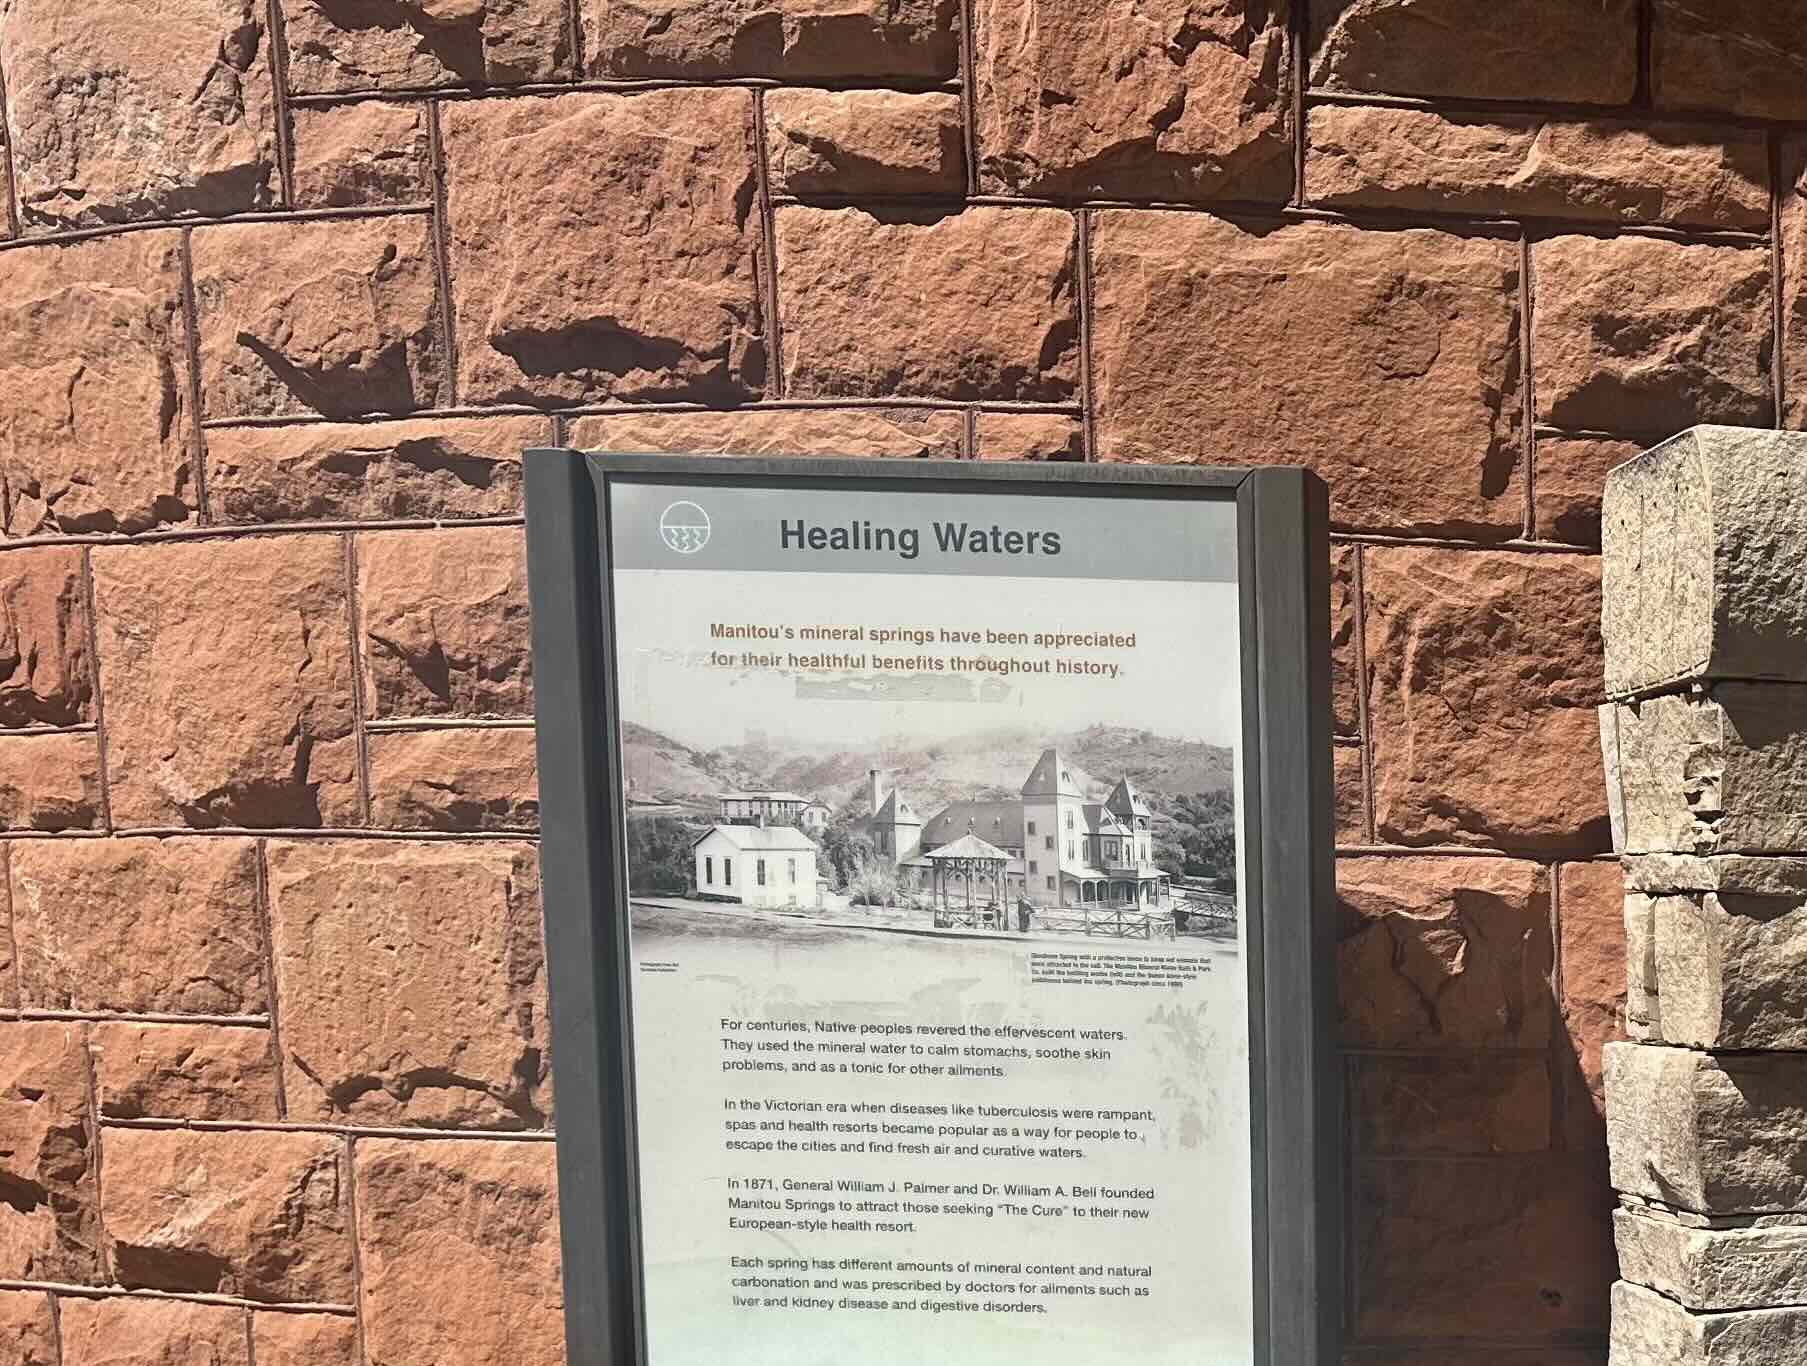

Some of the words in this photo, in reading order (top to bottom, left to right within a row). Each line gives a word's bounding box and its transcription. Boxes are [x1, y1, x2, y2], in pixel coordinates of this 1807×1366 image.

[780, 519, 920, 559] Healing
[933, 523, 1061, 555] Waters
[710, 623, 794, 638] Manitou's
[799, 626, 863, 640] mineral
[869, 628, 934, 645] springs
[939, 628, 981, 642] have
[986, 629, 1028, 644] been
[1033, 631, 1137, 648] appreciated
[710, 651, 737, 665] for
[741, 651, 783, 666] their
[787, 652, 866, 668] healthful
[871, 655, 944, 669] benefits
[950, 657, 1050, 675] throughout
[1056, 659, 1123, 678] history.
[720, 1018, 742, 1030] For
[814, 1021, 857, 1032] Native
[860, 1023, 912, 1036] peoples
[916, 1025, 966, 1035] revered
[969, 1024, 993, 1036] the
[995, 1025, 1075, 1038] effervescent
[722, 1038, 753, 1053] They
[757, 1040, 789, 1051] used
[793, 1040, 814, 1051] the
[817, 1042, 865, 1052] mineral
[869, 1043, 907, 1054] water
[909, 1044, 923, 1054] to
[927, 1044, 959, 1055] calm
[1035, 1047, 1081, 1058] soothe
[1084, 1048, 1110, 1059] skin
[791, 1061, 816, 1071] and
[819, 1063, 836, 1072] as
[839, 1063, 847, 1072] a
[851, 1063, 883, 1073] tonic
[887, 1062, 906, 1073] for
[909, 1063, 944, 1074] other
[724, 1098, 736, 1109] In
[739, 1099, 761, 1110] the
[763, 1099, 822, 1111] Victorian
[824, 1103, 847, 1112] era
[850, 1102, 885, 1112] when
[889, 1103, 948, 1114] diseases
[951, 1103, 974, 1115] like
[977, 1106, 1058, 1117] tuberculosis
[1061, 1109, 1093, 1118] were
[725, 1121, 756, 1132] spas
[759, 1120, 784, 1130] and
[788, 1120, 828, 1131] health
[832, 1122, 877, 1132] resorts
[881, 1123, 934, 1134] became
[938, 1125, 989, 1137] popular
[992, 1127, 1007, 1136] as
[1011, 1127, 1020, 1136] a
[1023, 1128, 1049, 1140] way
[1053, 1126, 1072, 1137] for
[1075, 1128, 1121, 1141] people
[1124, 1128, 1137, 1139] to
[725, 1140, 773, 1152] escape
[776, 1139, 797, 1150] the
[799, 1141, 836, 1151] cities
[840, 1141, 865, 1152] and
[868, 1141, 893, 1152] find
[897, 1142, 929, 1153] fresh
[933, 1143, 951, 1154] air
[953, 1144, 979, 1155] and
[982, 1145, 1035, 1156] curative
[727, 1177, 739, 1188] In
[782, 1178, 833, 1190] General
[836, 1180, 884, 1192] William
[903, 1182, 950, 1193] Palmer
[952, 1183, 978, 1194] and
[1003, 1184, 1050, 1196] William
[1072, 1186, 1096, 1197] Bell
[1100, 1187, 1154, 1198] founded
[728, 1197, 781, 1209] Manitou
[785, 1198, 835, 1213] Springs
[838, 1200, 852, 1211] to
[855, 1201, 899, 1212] attract
[902, 1201, 939, 1213] those
[942, 1203, 993, 1217] seeking
[1072, 1206, 1086, 1216] to
[1089, 1206, 1119, 1217] their
[1122, 1209, 1149, 1218] new
[729, 1217, 827, 1232] European-style
[831, 1219, 871, 1230] health
[731, 1256, 763, 1267] Each
[767, 1258, 808, 1271] spring
[811, 1257, 835, 1269] has
[838, 1258, 892, 1270] different
[896, 1262, 953, 1271] amounts
[956, 1261, 970, 1272] of
[974, 1263, 1021, 1273] mineral
[1024, 1264, 1075, 1274] content
[1078, 1265, 1103, 1275] and
[1107, 1266, 1151, 1276] natural
[731, 1277, 809, 1287] carbonation
[813, 1278, 838, 1288] and
[841, 1280, 868, 1289] was
[871, 1280, 941, 1292] prescribed
[945, 1280, 961, 1295] by
[964, 1281, 1015, 1292] doctors
[1018, 1282, 1037, 1293] for
[1040, 1283, 1095, 1294] ailments
[1098, 1285, 1130, 1295] such
[1134, 1287, 1149, 1296] as
[732, 1295, 761, 1306] liver
[763, 1296, 788, 1307] and
[791, 1297, 834, 1311] kidney
[838, 1298, 889, 1309] disease
[891, 1299, 916, 1310] and
[920, 1300, 979, 1313] digestive
